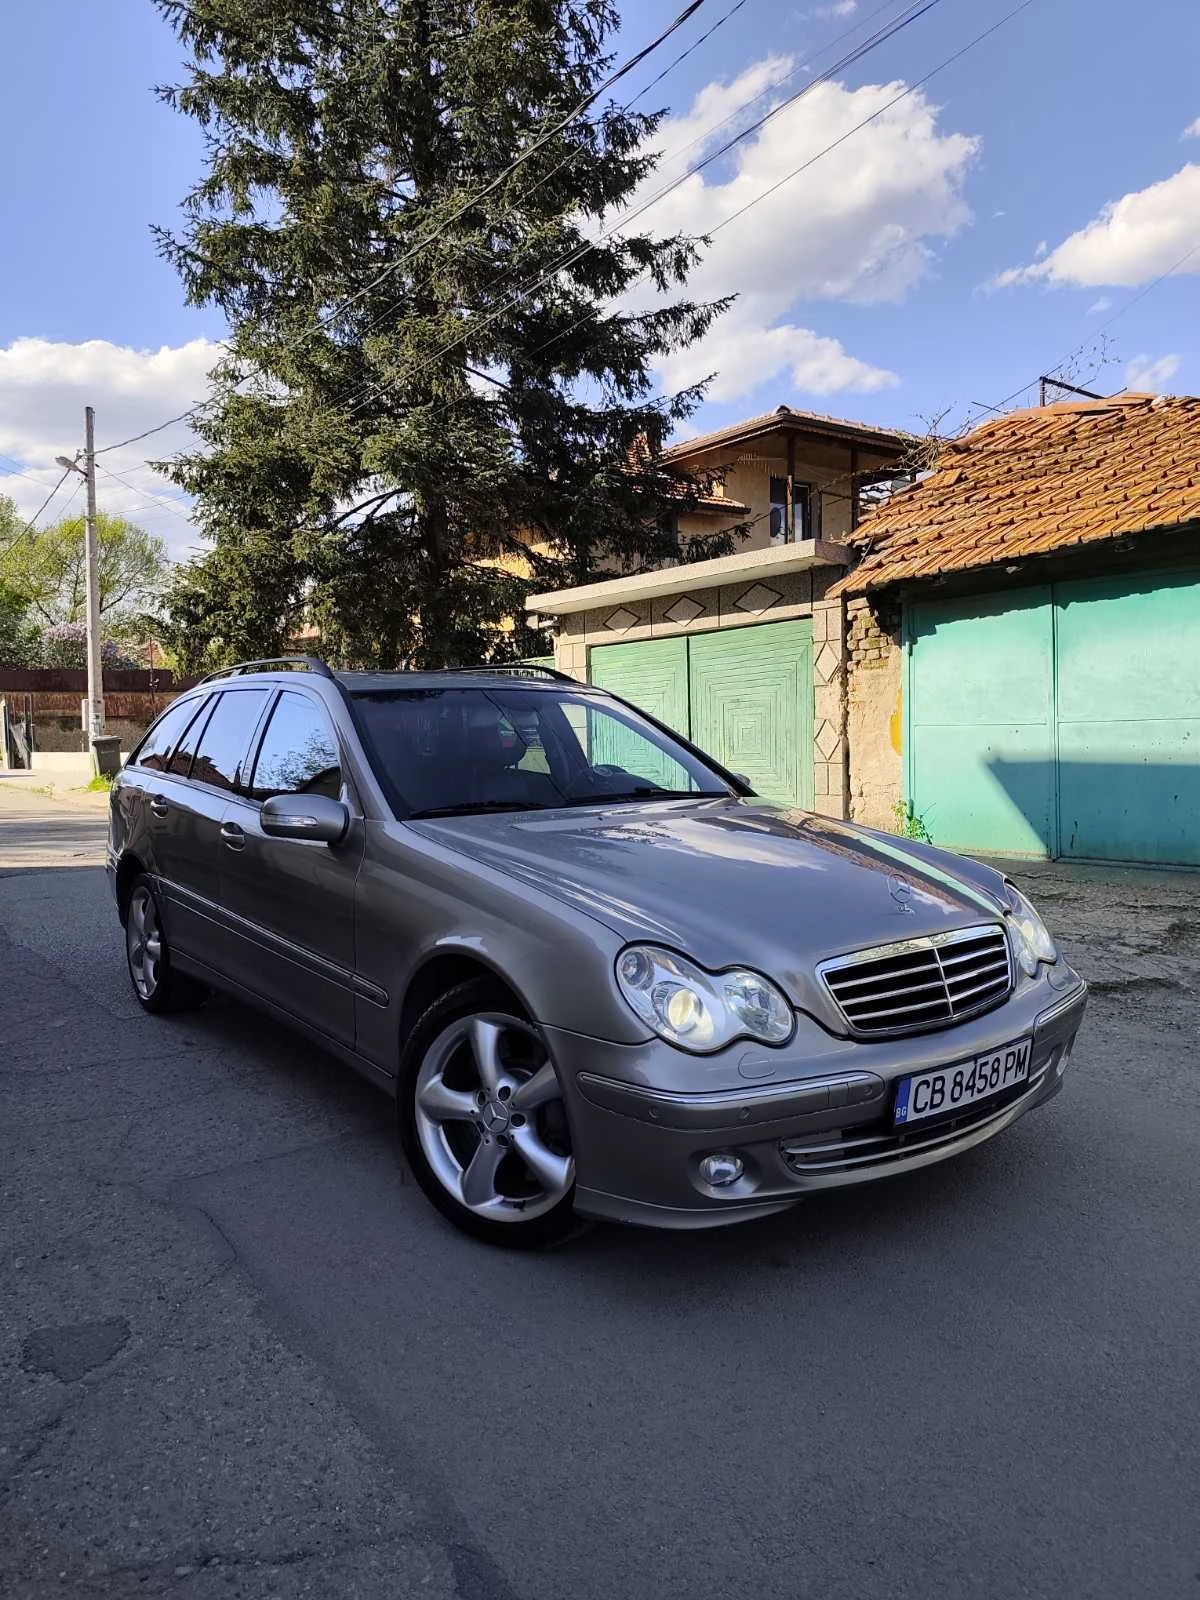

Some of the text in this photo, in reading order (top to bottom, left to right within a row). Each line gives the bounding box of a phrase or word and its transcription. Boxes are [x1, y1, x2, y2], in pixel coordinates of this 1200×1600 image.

[913, 1045, 1028, 1113] CB 8458 PM
[895, 1106, 907, 1118] BG
